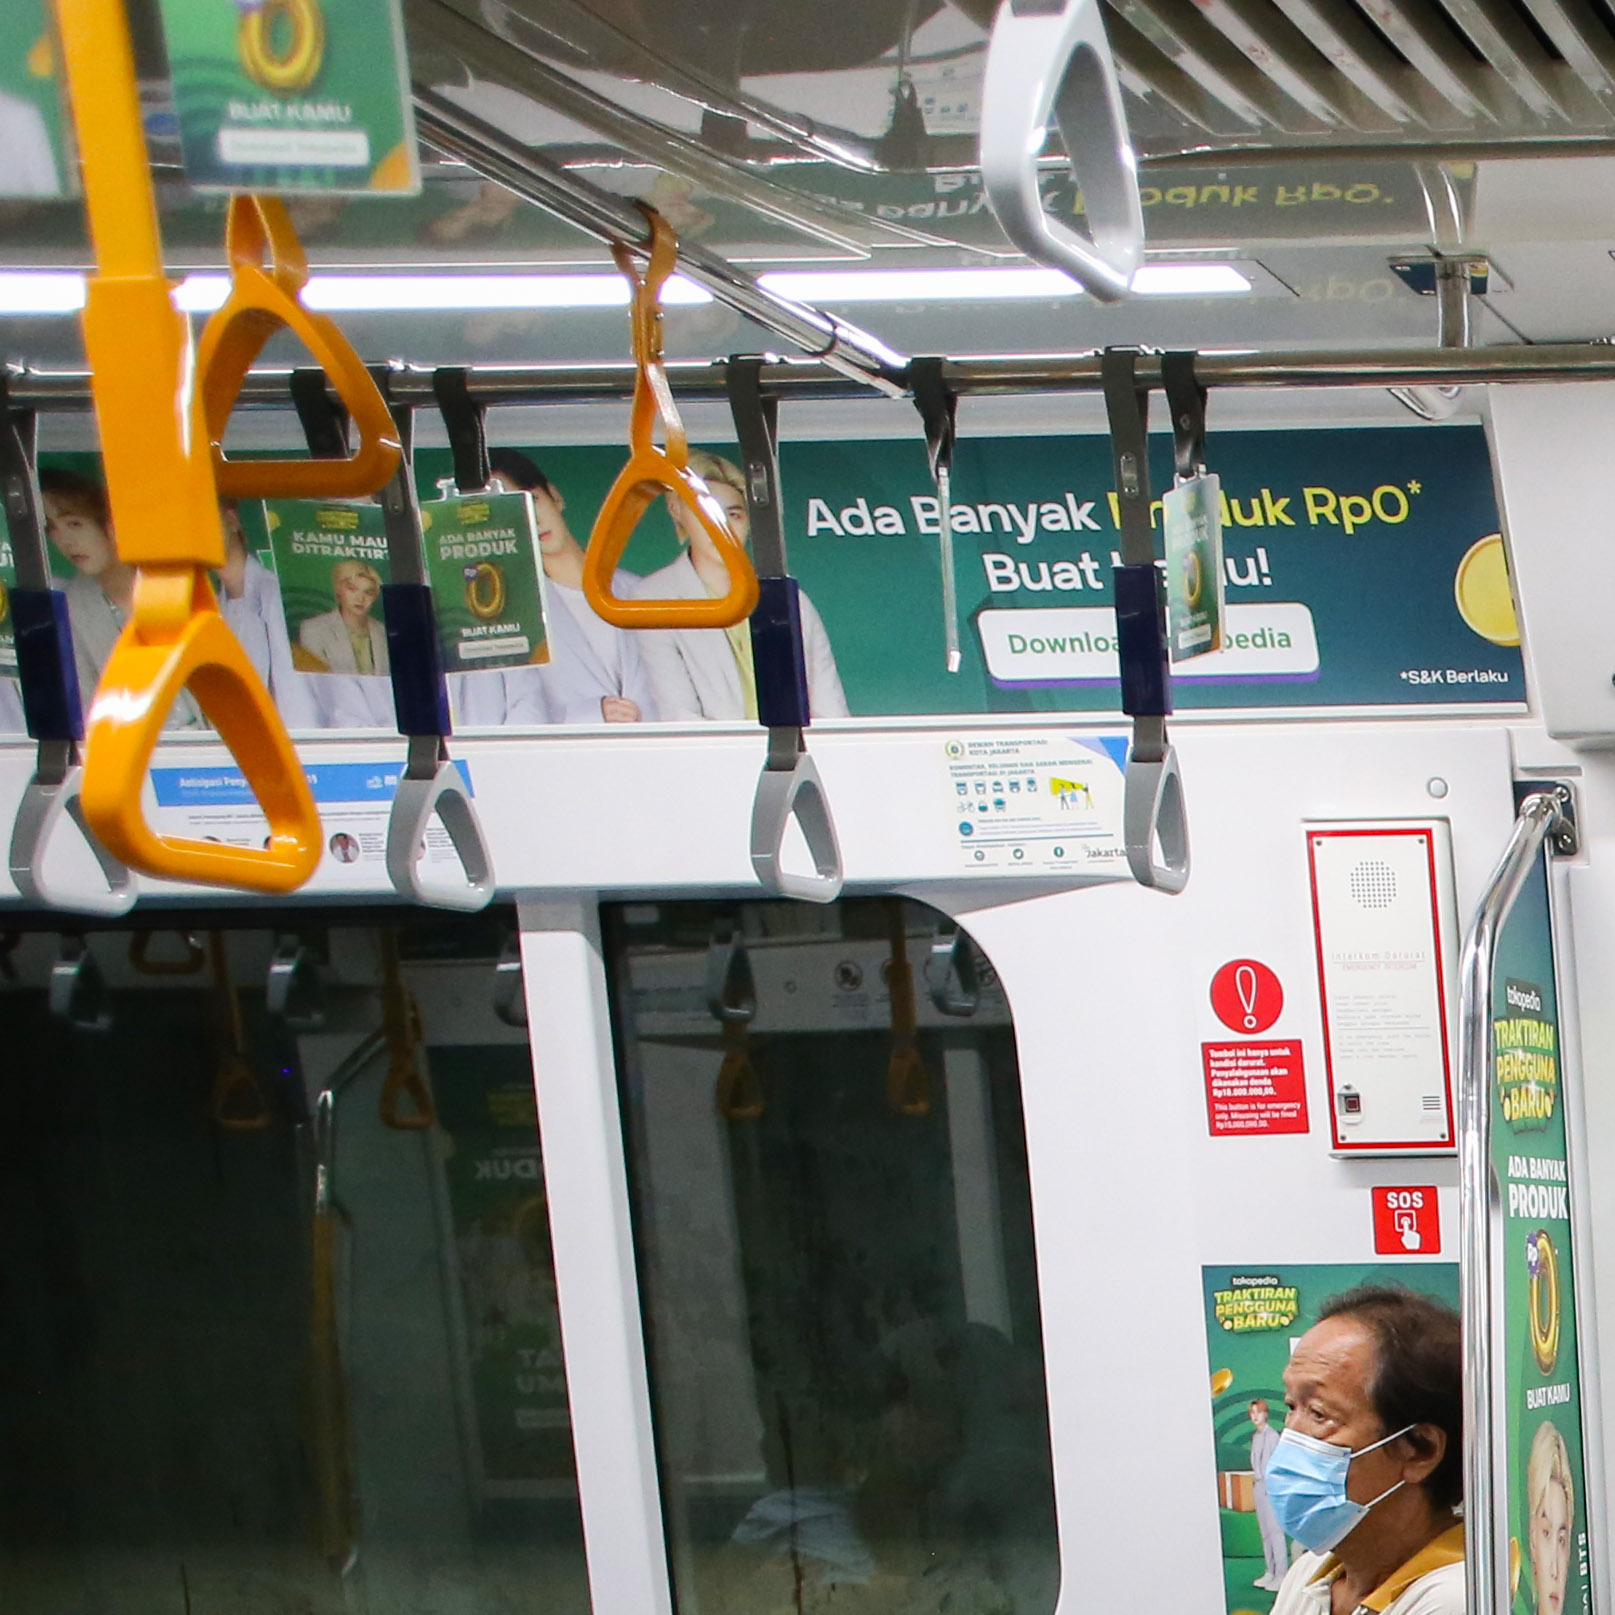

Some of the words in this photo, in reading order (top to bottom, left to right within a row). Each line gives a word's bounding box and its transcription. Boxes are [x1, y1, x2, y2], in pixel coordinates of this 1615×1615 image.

[807, 496, 906, 537] Ada
[909, 491, 1102, 544] Banyak
[292, 530, 344, 544] KAMU
[467, 528, 516, 542] BANYAK
[439, 539, 519, 560] PRODUK
[981, 551, 1104, 592] Buat
[1446, 668, 1509, 684] Berlaku
[1506, 985, 1541, 1013] tokopedia
[1493, 1019, 1554, 1051] TRAKTIRAN
[1496, 1053, 1556, 1085] PENGGUNA
[1511, 1086, 1545, 1121] BARU
[1508, 1155, 1527, 1179] ADA
[1529, 1156, 1566, 1181] BANYAK
[1387, 1192, 1424, 1209] SOS
[1508, 1182, 1568, 1220] PRODUK
[1232, 1276, 1278, 1287] tokopedia
[1214, 1287, 1297, 1304] TRAKTIRAN
[1215, 1299, 1297, 1318] PENGGUNA
[1233, 1313, 1280, 1330] BARU
[1526, 1385, 1548, 1410] BUAT
[1547, 1382, 1571, 1405] KAMU
